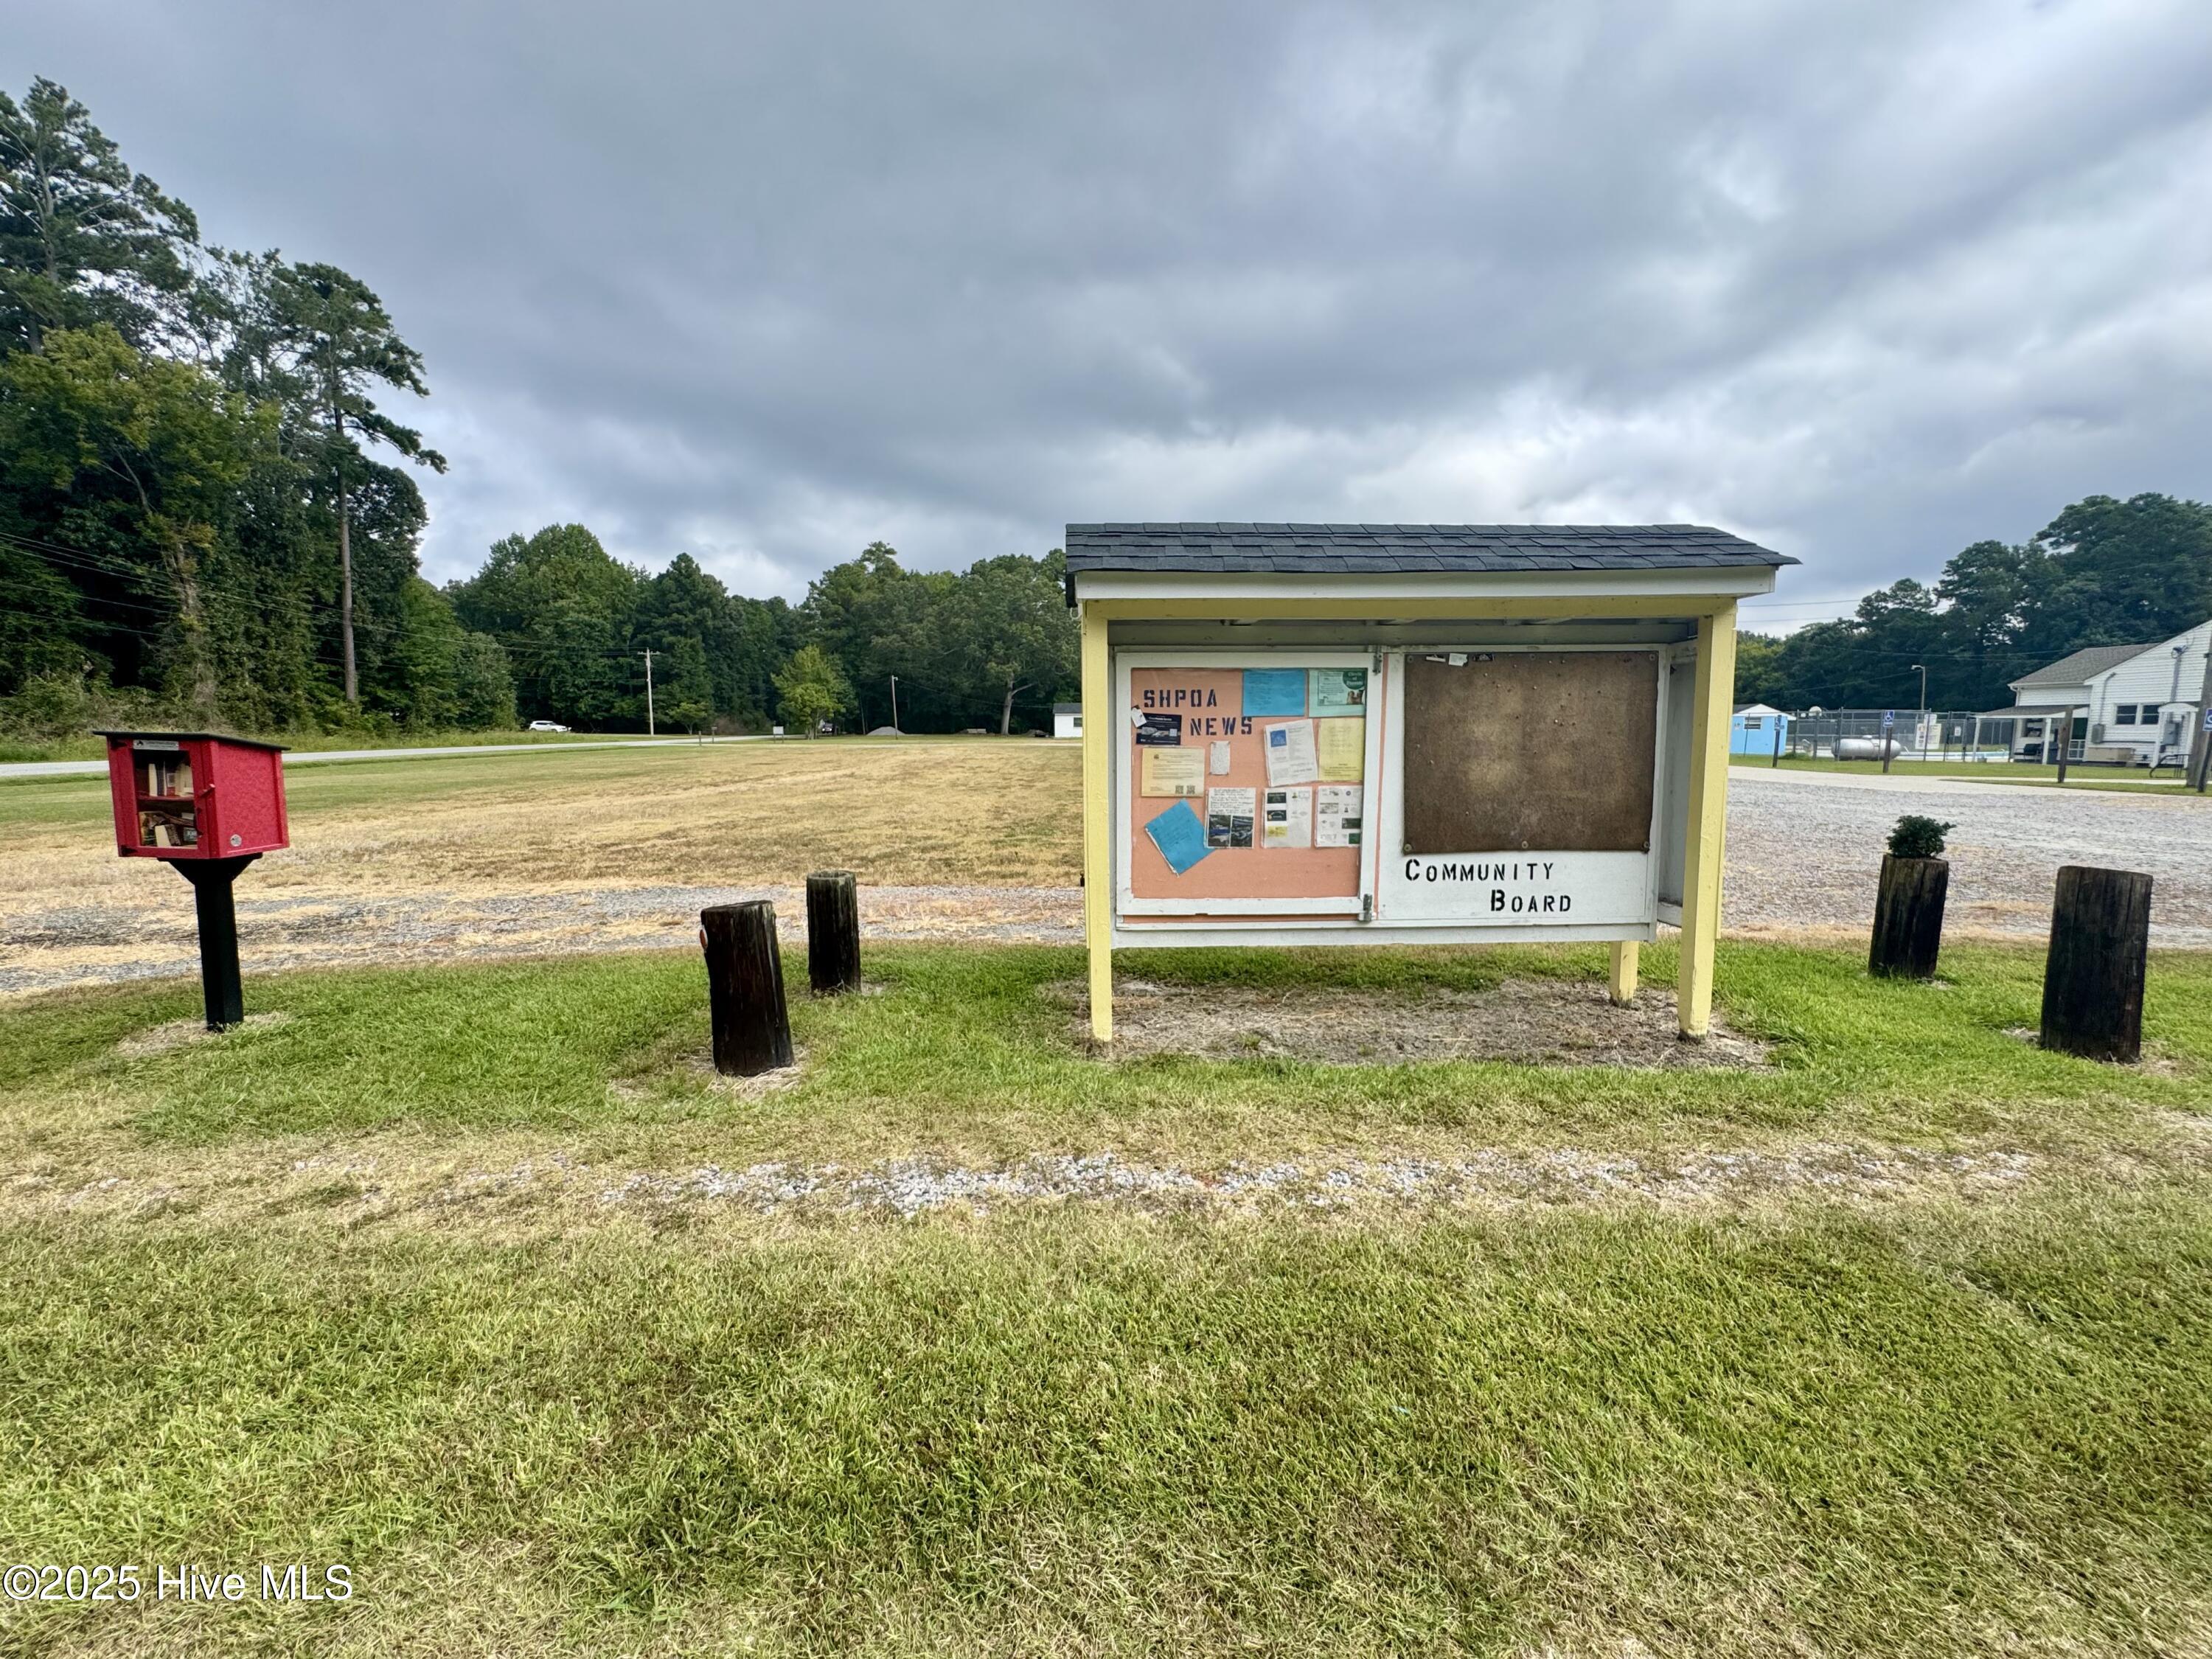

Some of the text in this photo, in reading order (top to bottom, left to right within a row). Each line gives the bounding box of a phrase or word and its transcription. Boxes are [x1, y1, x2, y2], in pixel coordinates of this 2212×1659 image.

[1144, 689, 1217, 708] SHPOA
[1190, 717, 1253, 736] NEWS
[1405, 858, 1554, 883] COMMUNITY
[1490, 889, 1571, 913] BOARD
